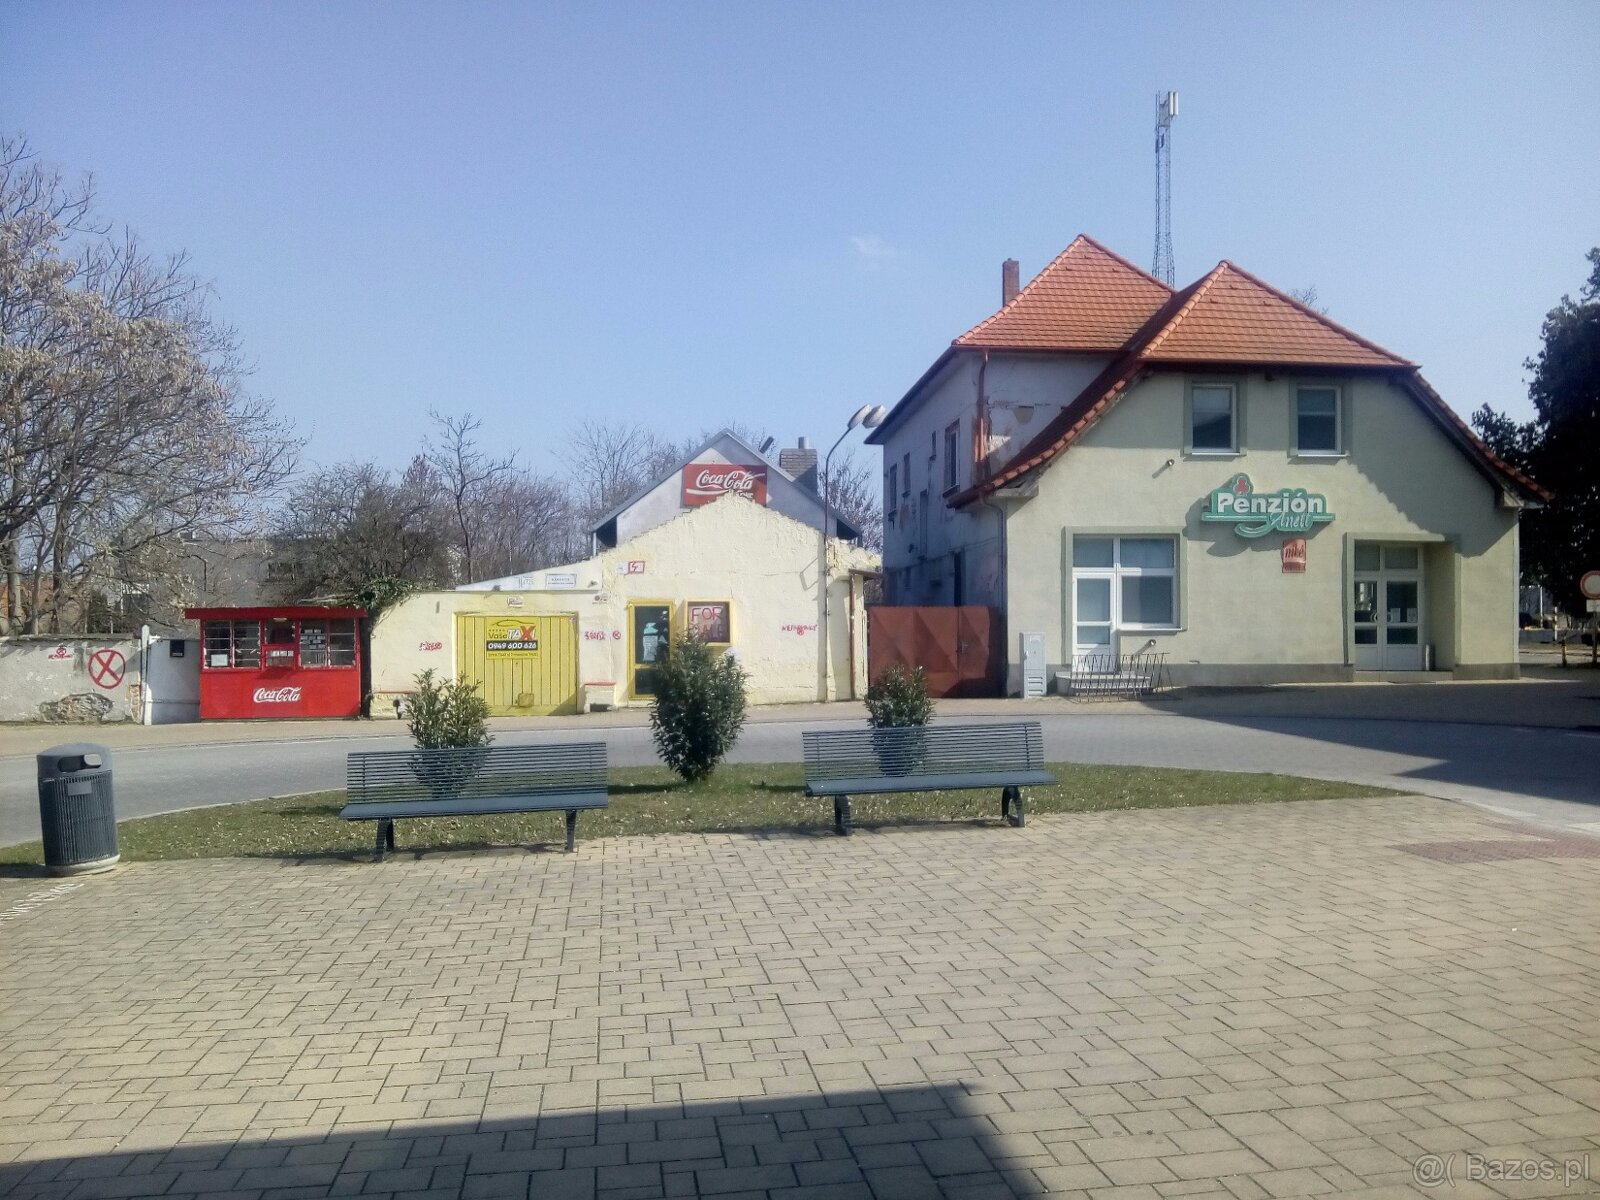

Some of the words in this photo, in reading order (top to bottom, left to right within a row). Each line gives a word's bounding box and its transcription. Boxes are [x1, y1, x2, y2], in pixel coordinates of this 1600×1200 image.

[1217, 491, 1323, 513] Penzión
[691, 606, 724, 622] FOR
[507, 625, 536, 641] TAXI
